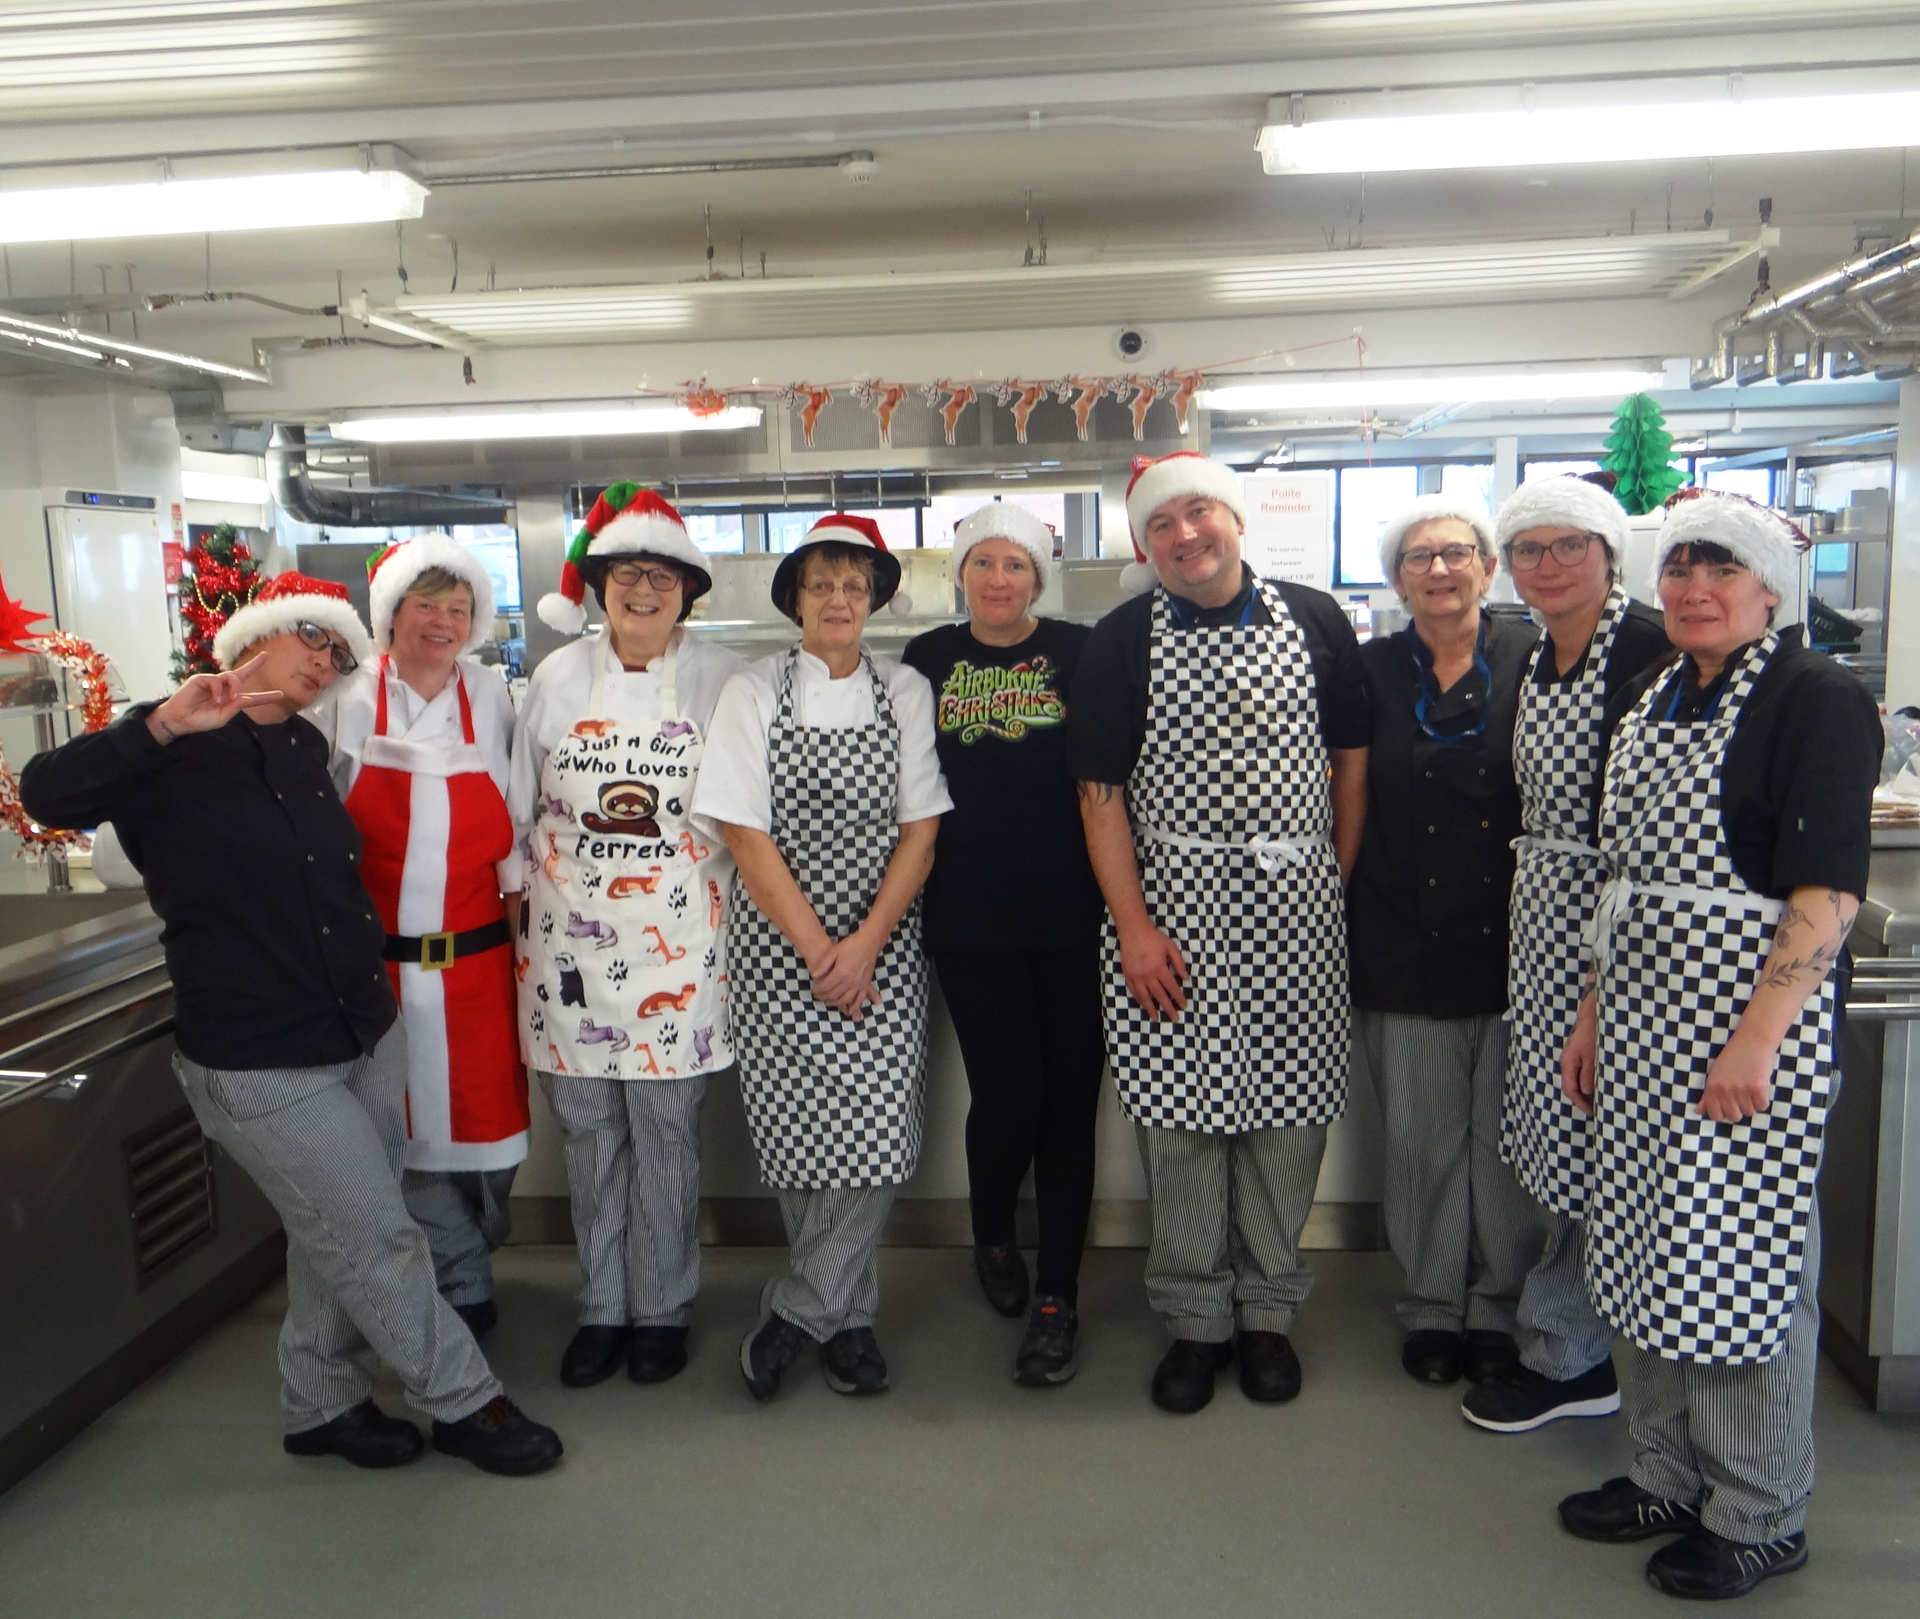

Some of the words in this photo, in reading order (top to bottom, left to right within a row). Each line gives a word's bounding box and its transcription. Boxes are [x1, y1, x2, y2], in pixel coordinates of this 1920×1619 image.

[1271, 489, 1301, 499] Polite
[1261, 503, 1312, 513] Reminder
[579, 734, 619, 752] Just
[650, 736, 686, 758] Girl
[572, 756, 617, 774] Who
[625, 758, 689, 779] Loves
[575, 834, 676, 859] Ferrets
